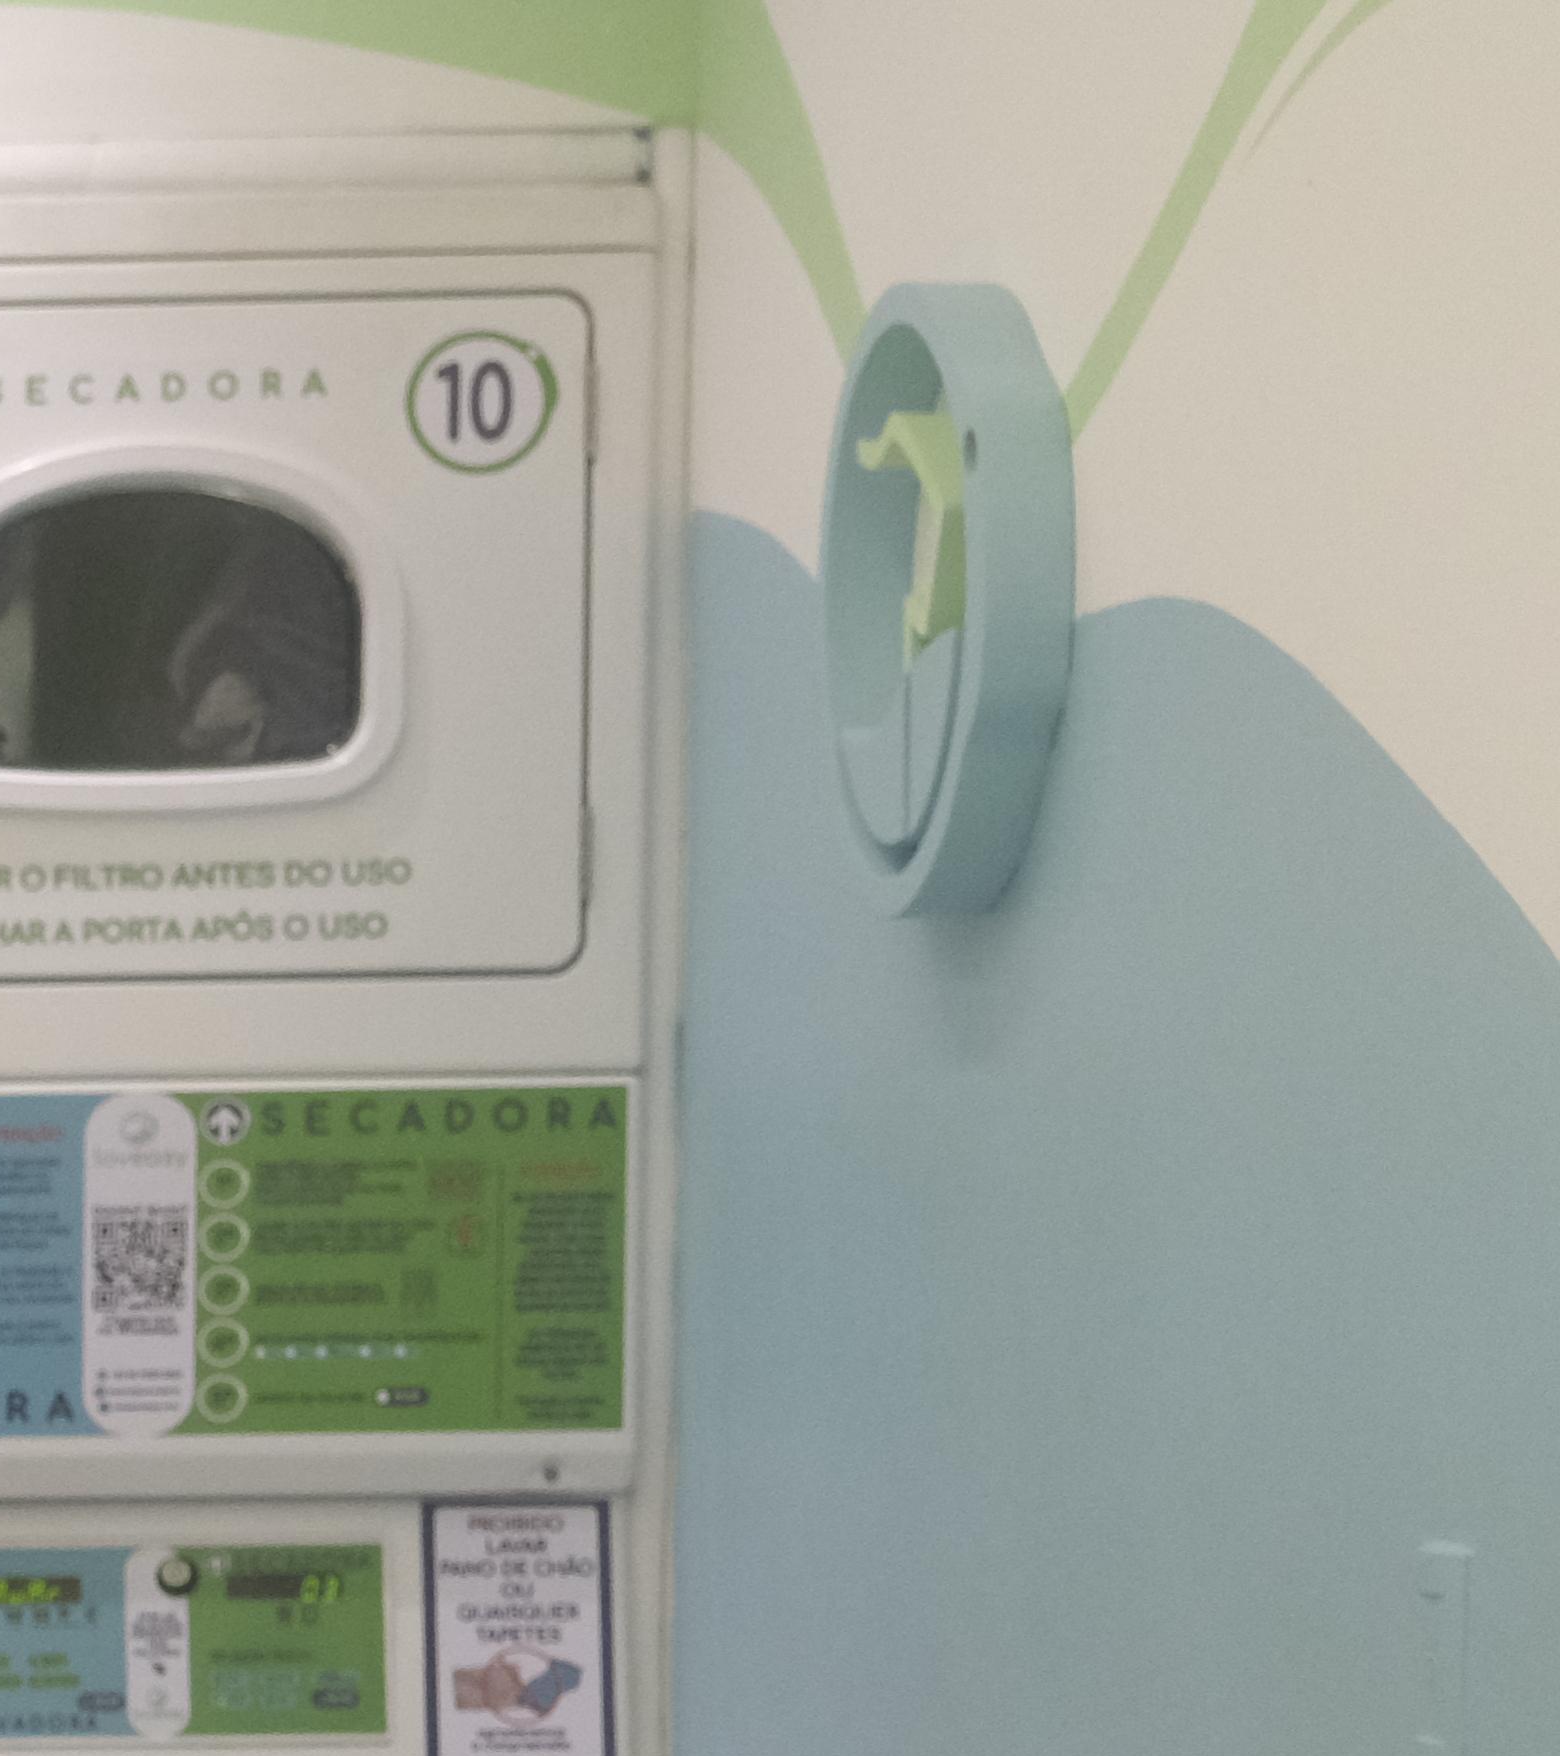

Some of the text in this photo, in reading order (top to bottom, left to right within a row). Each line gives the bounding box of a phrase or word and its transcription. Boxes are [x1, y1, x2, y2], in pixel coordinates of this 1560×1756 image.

[437, 359, 512, 441] 10
[19, 866, 47, 891] O
[52, 864, 162, 891] FILTRO
[169, 861, 276, 889] ANTES
[285, 860, 333, 887] DO
[342, 858, 412, 886] USO
[53, 920, 74, 947] A
[82, 919, 183, 944] PORTA
[190, 911, 276, 943] APÓS
[283, 916, 308, 942] O
[318, 913, 388, 940] USO
[261, 1096, 617, 1136] SECADORA
[467, 1514, 564, 1532] PROIBIDO
[486, 1537, 548, 1554] LAVAR
